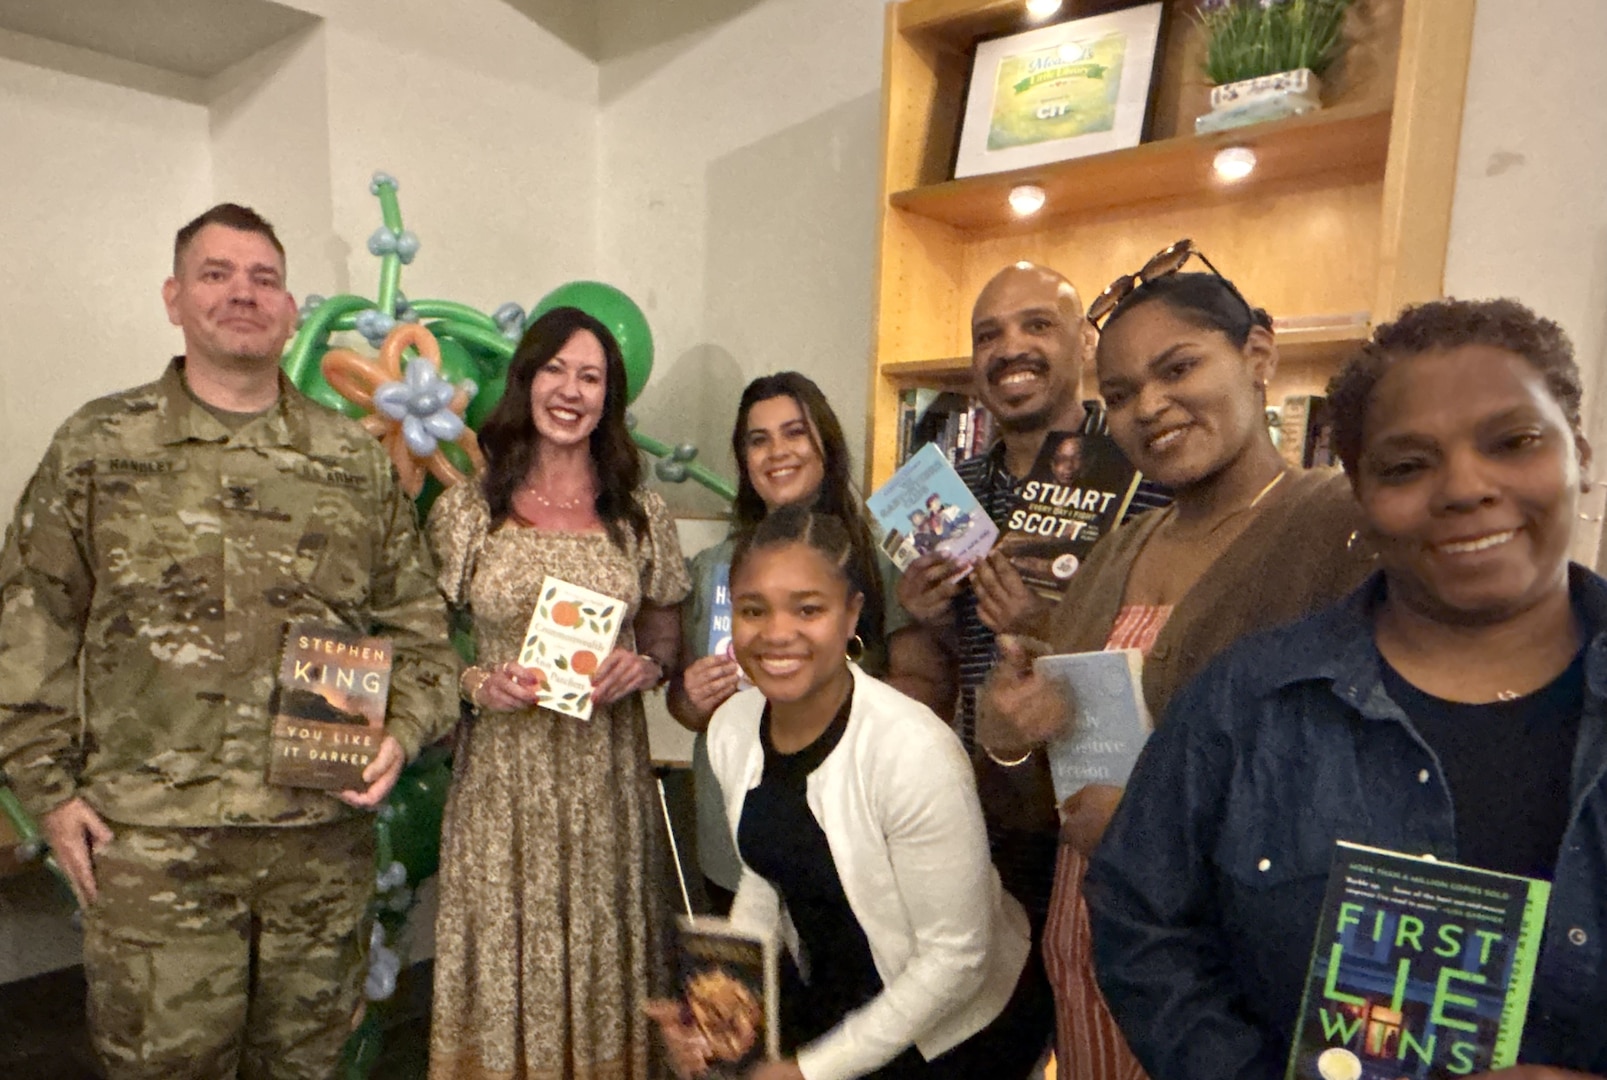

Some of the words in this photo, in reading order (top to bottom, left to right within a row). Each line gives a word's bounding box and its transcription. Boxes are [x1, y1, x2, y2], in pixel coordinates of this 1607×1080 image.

[1037, 102, 1068, 119] CIT
[1022, 481, 1116, 513] STUART
[1008, 510, 1087, 541] SCOTT
[299, 636, 384, 662] STEPHEN
[294, 660, 381, 693] KING
[287, 726, 322, 741] YOU
[334, 732, 371, 747] LIKE
[283, 747, 300, 757] IT
[309, 749, 369, 766] DARKER
[1336, 901, 1503, 965] FIRST
[1323, 942, 1487, 1033] LIE
[1319, 1007, 1477, 1075] WINS
